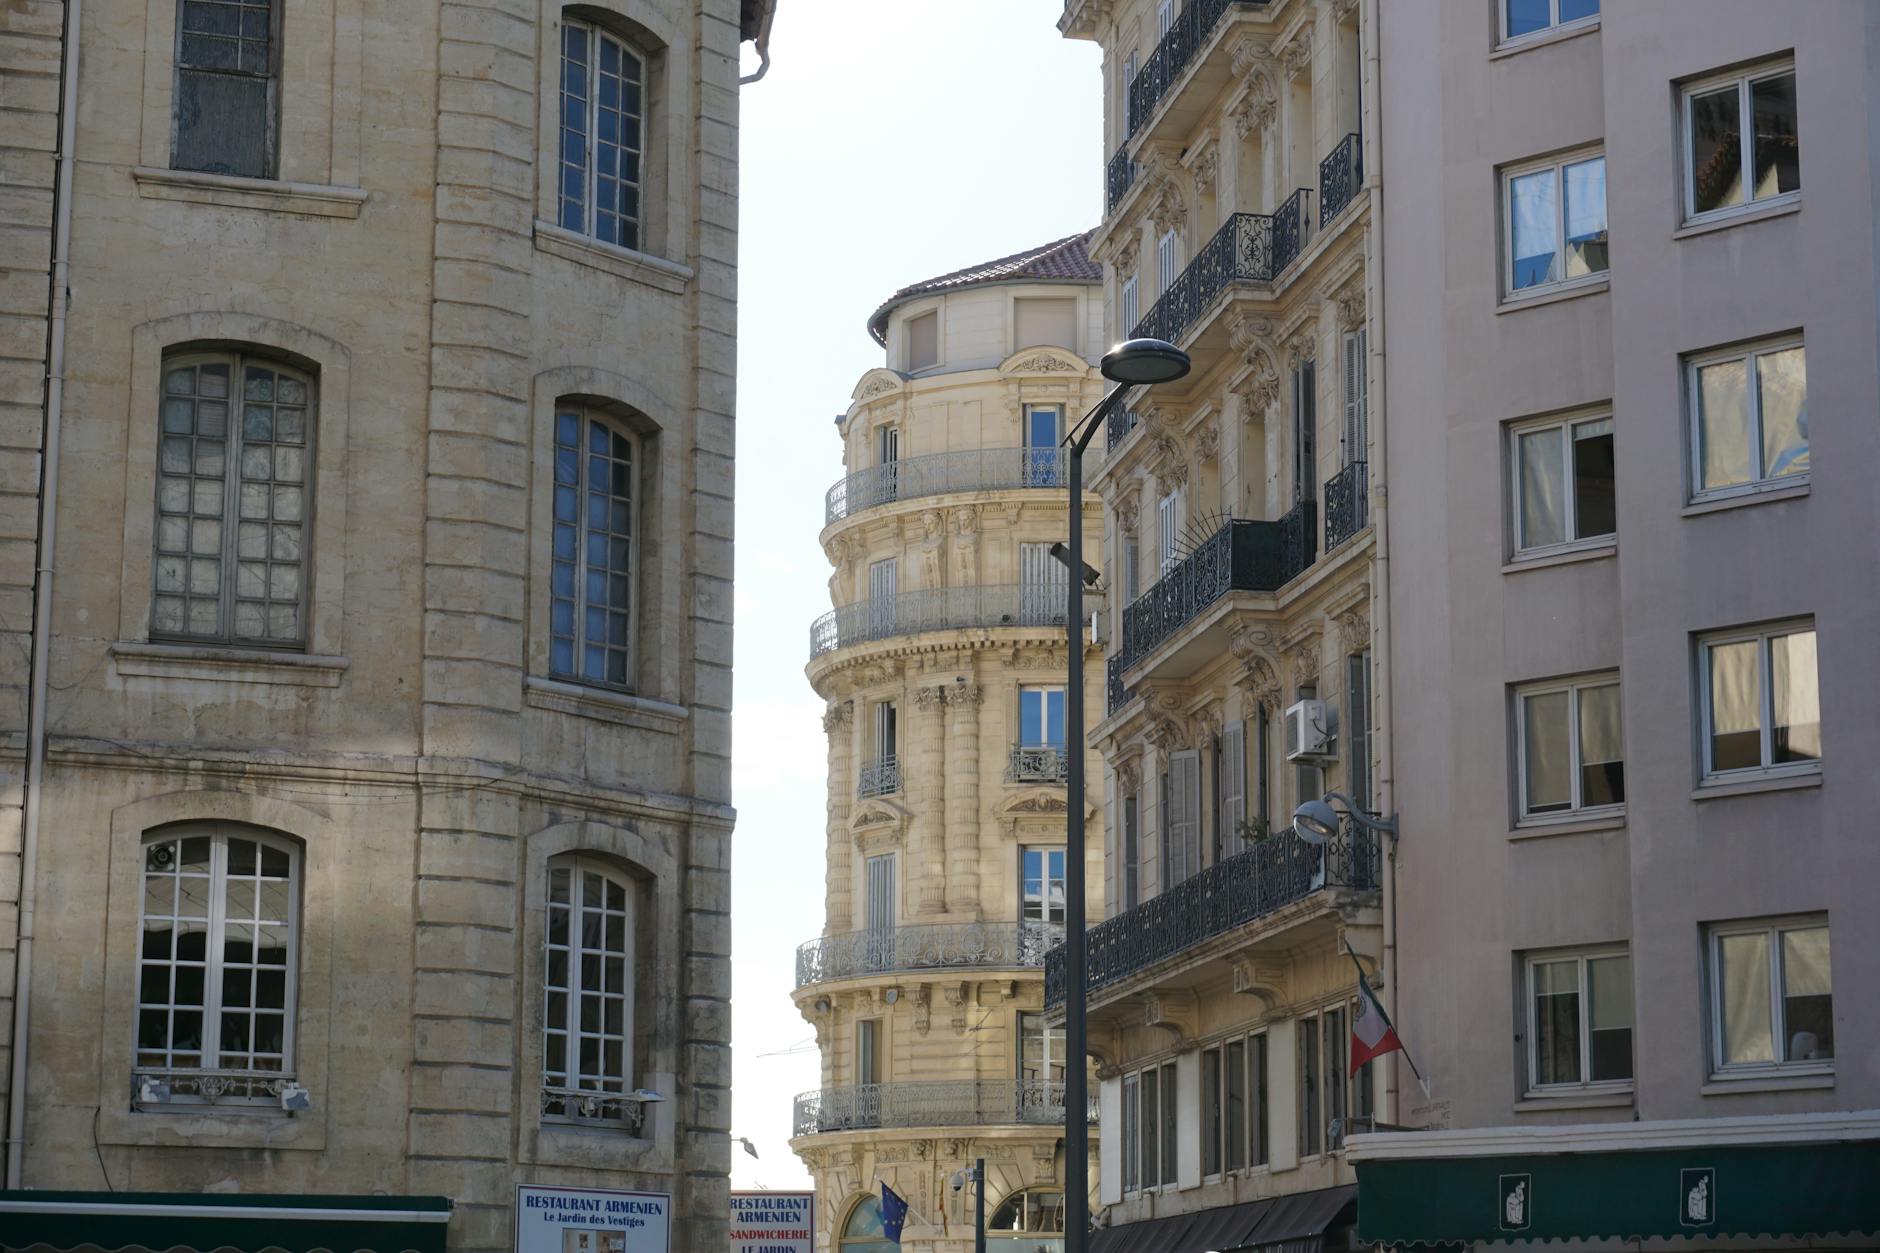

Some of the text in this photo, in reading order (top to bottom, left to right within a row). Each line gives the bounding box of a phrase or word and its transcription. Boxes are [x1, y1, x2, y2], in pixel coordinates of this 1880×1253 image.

[526, 1195, 662, 1215] RESTAURANT ARMENIEN
[730, 1198, 809, 1209] RESTAURANT
[544, 1211, 645, 1228] Le Jardin des Vestiges
[737, 1211, 801, 1222] ARMENIEN
[730, 1229, 810, 1240] SANDWICHERIE
